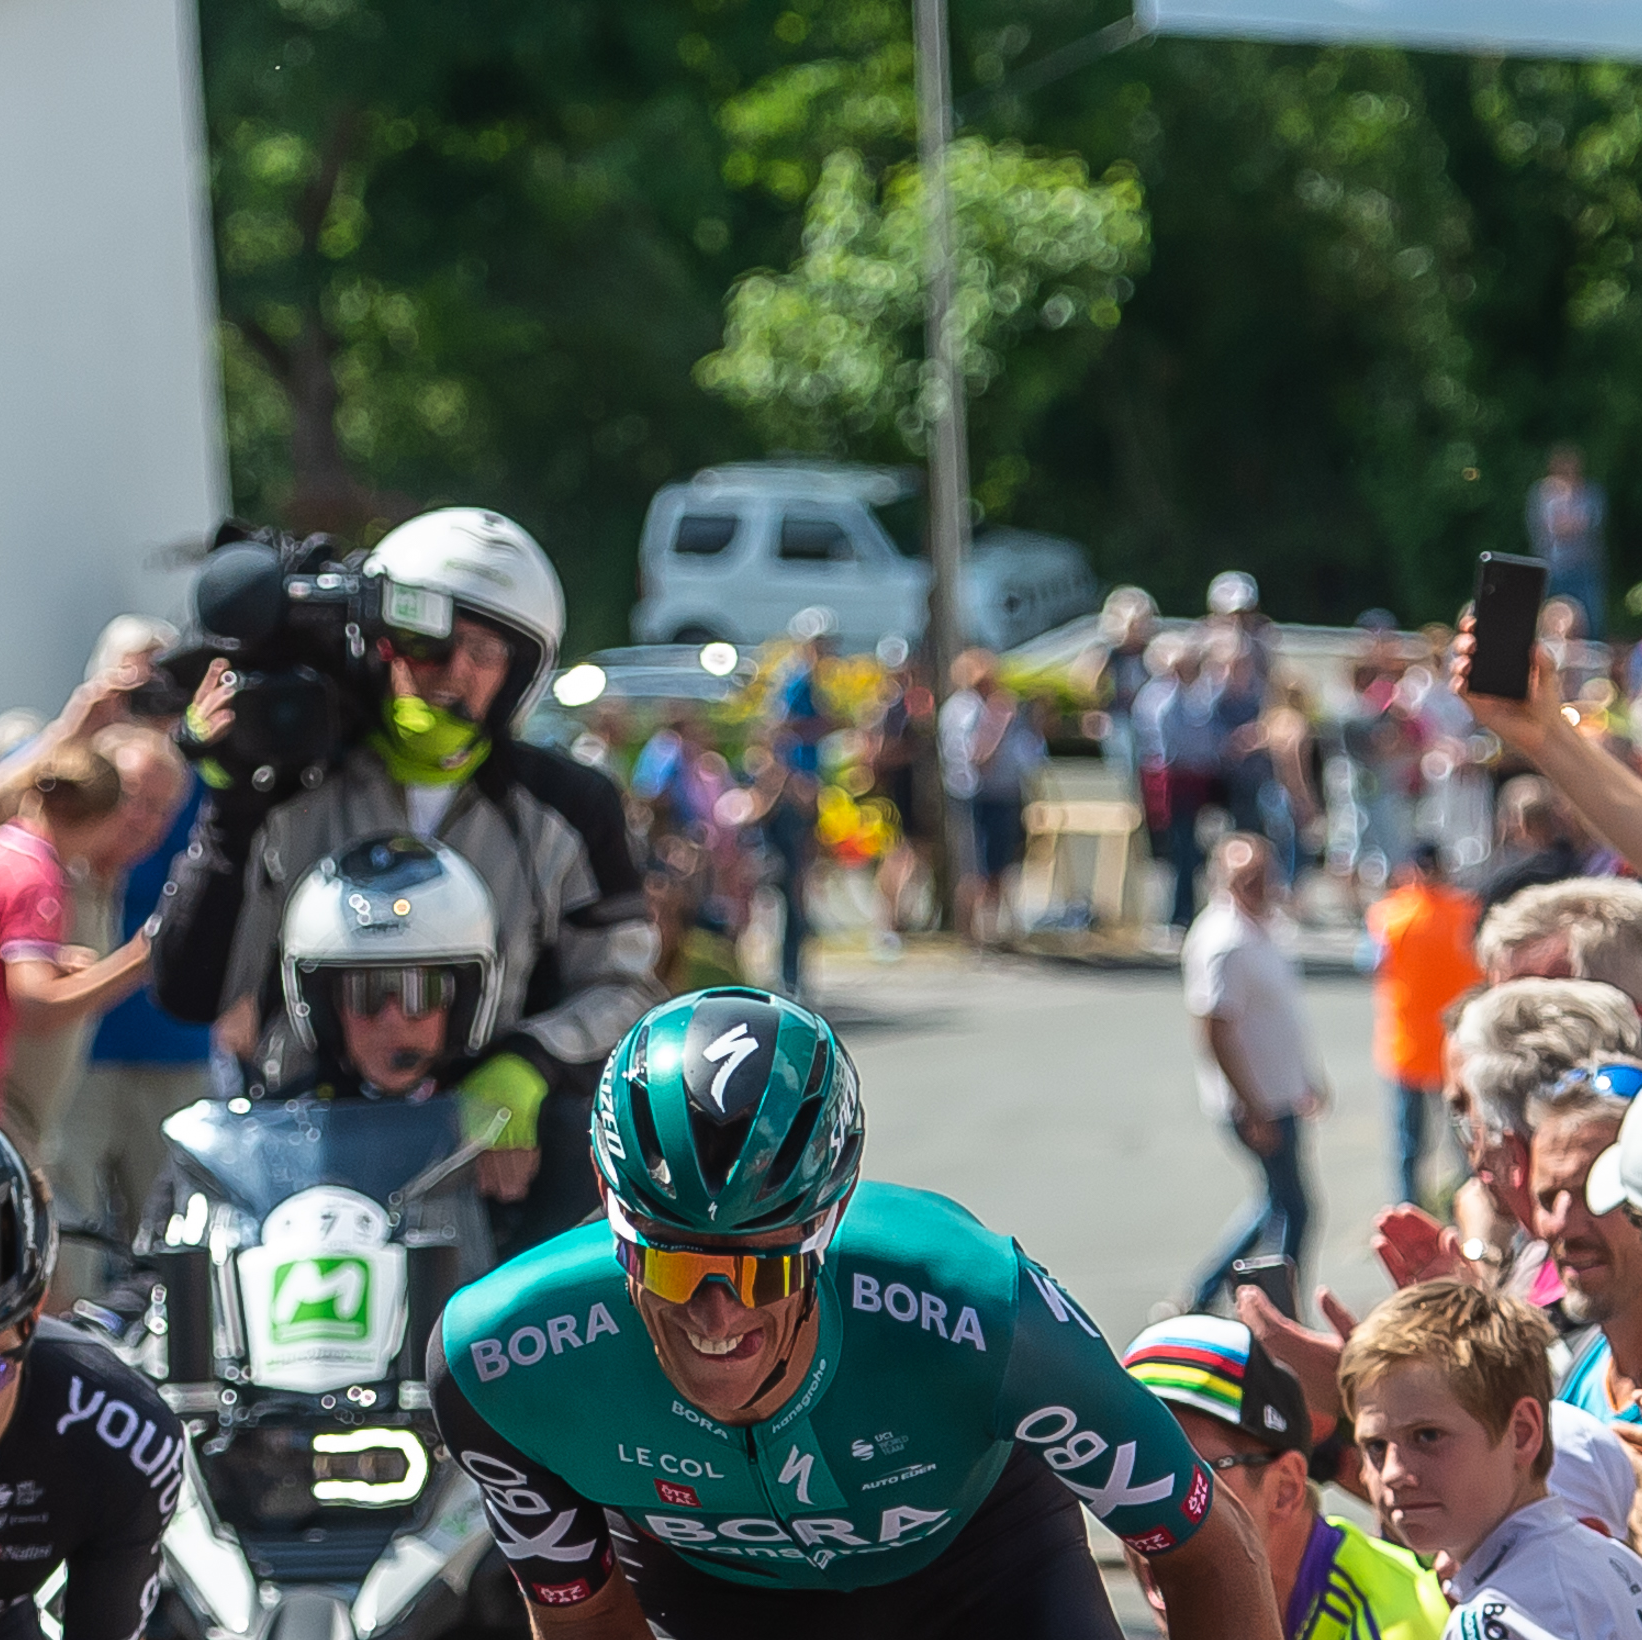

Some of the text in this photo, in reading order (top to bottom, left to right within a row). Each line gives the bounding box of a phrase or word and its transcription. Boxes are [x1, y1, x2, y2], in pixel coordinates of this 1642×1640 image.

[597, 1053, 627, 1161] ALIZED
[852, 1272, 987, 1352] BORA
[470, 1302, 620, 1383] BORA
[671, 1400, 729, 1440] BORA
[771, 1358, 828, 1434] hansgrohe
[618, 1443, 725, 1480] LE COL
[861, 1476, 899, 1491] AUTO
[645, 1505, 949, 1547] BORA
